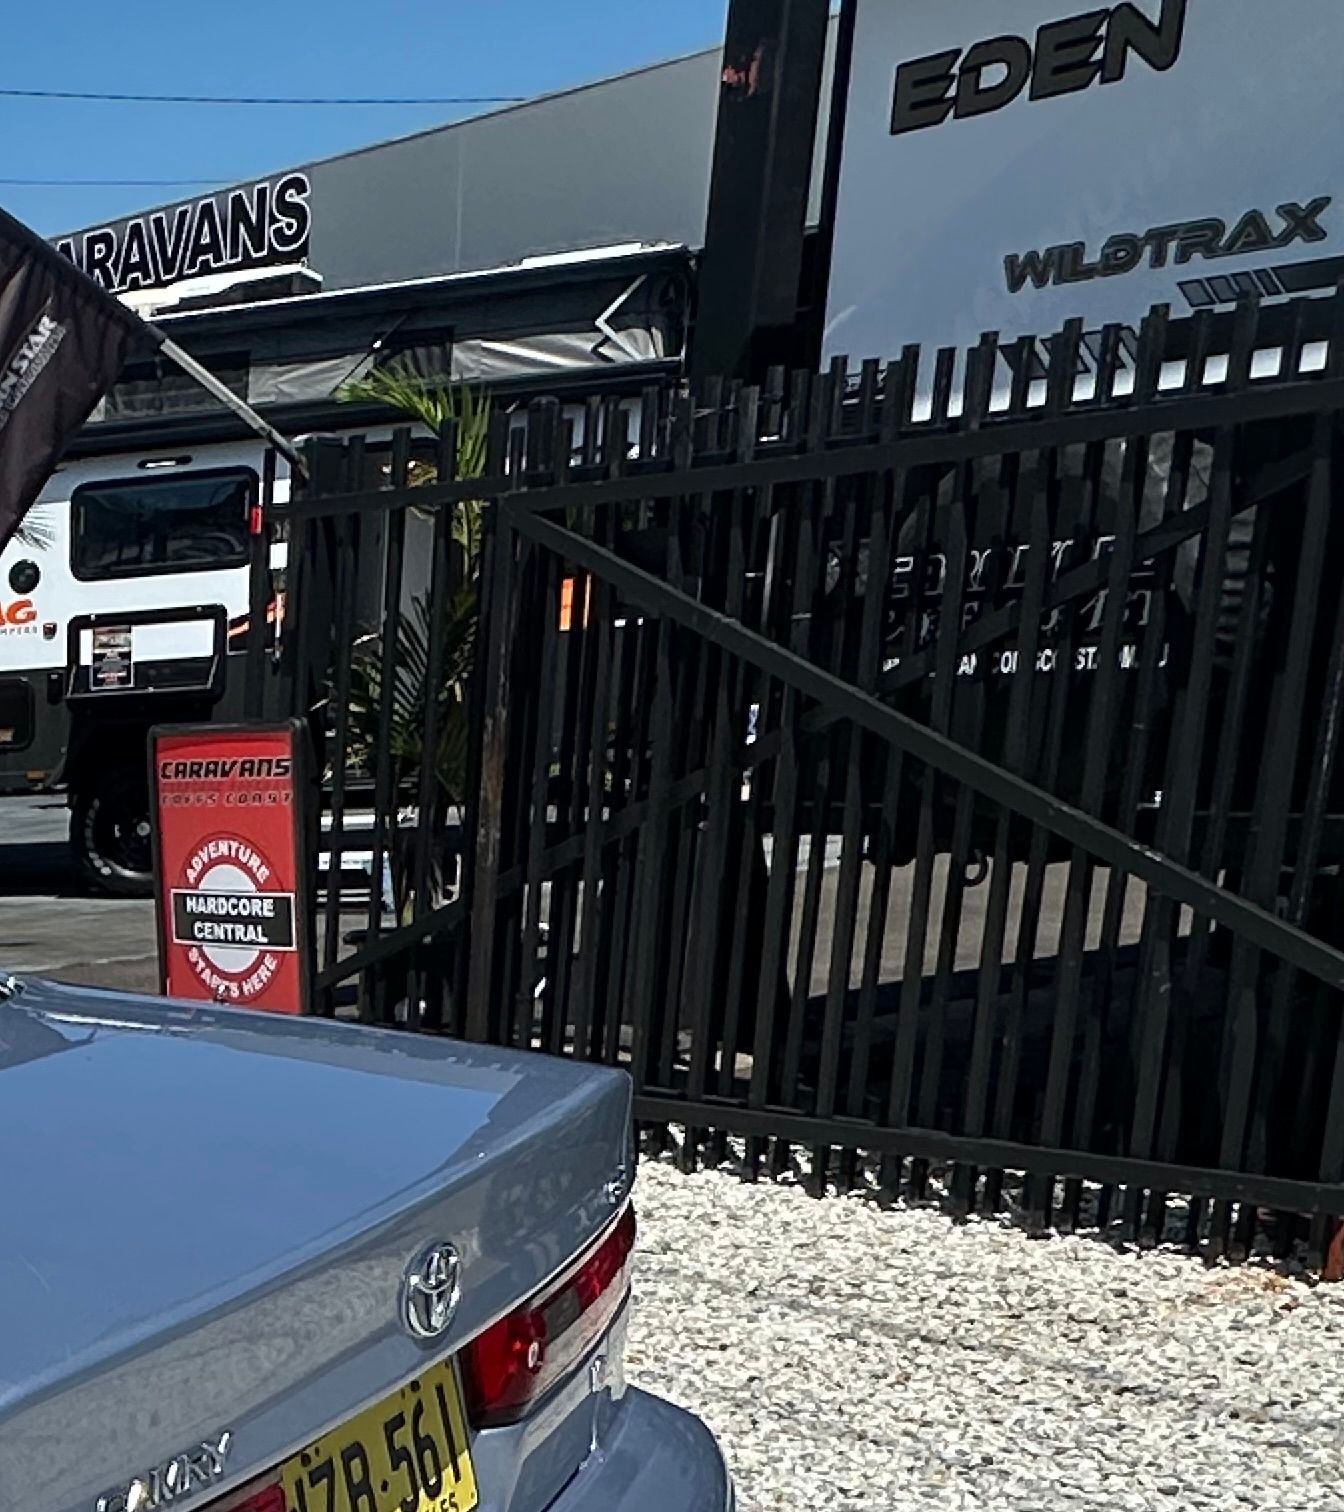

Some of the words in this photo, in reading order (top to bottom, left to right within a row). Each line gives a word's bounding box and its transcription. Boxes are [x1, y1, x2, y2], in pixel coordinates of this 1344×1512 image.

[889, 0, 1188, 136] EDEN
[1003, 196, 1332, 294] WILDTRAX
[160, 757, 292, 781] CARAVANS
[185, 839, 271, 884] ADVENTURE
[185, 896, 275, 918] HARDCORE
[192, 920, 270, 944] CENTRAL
[241, 952, 278, 996] HERE
